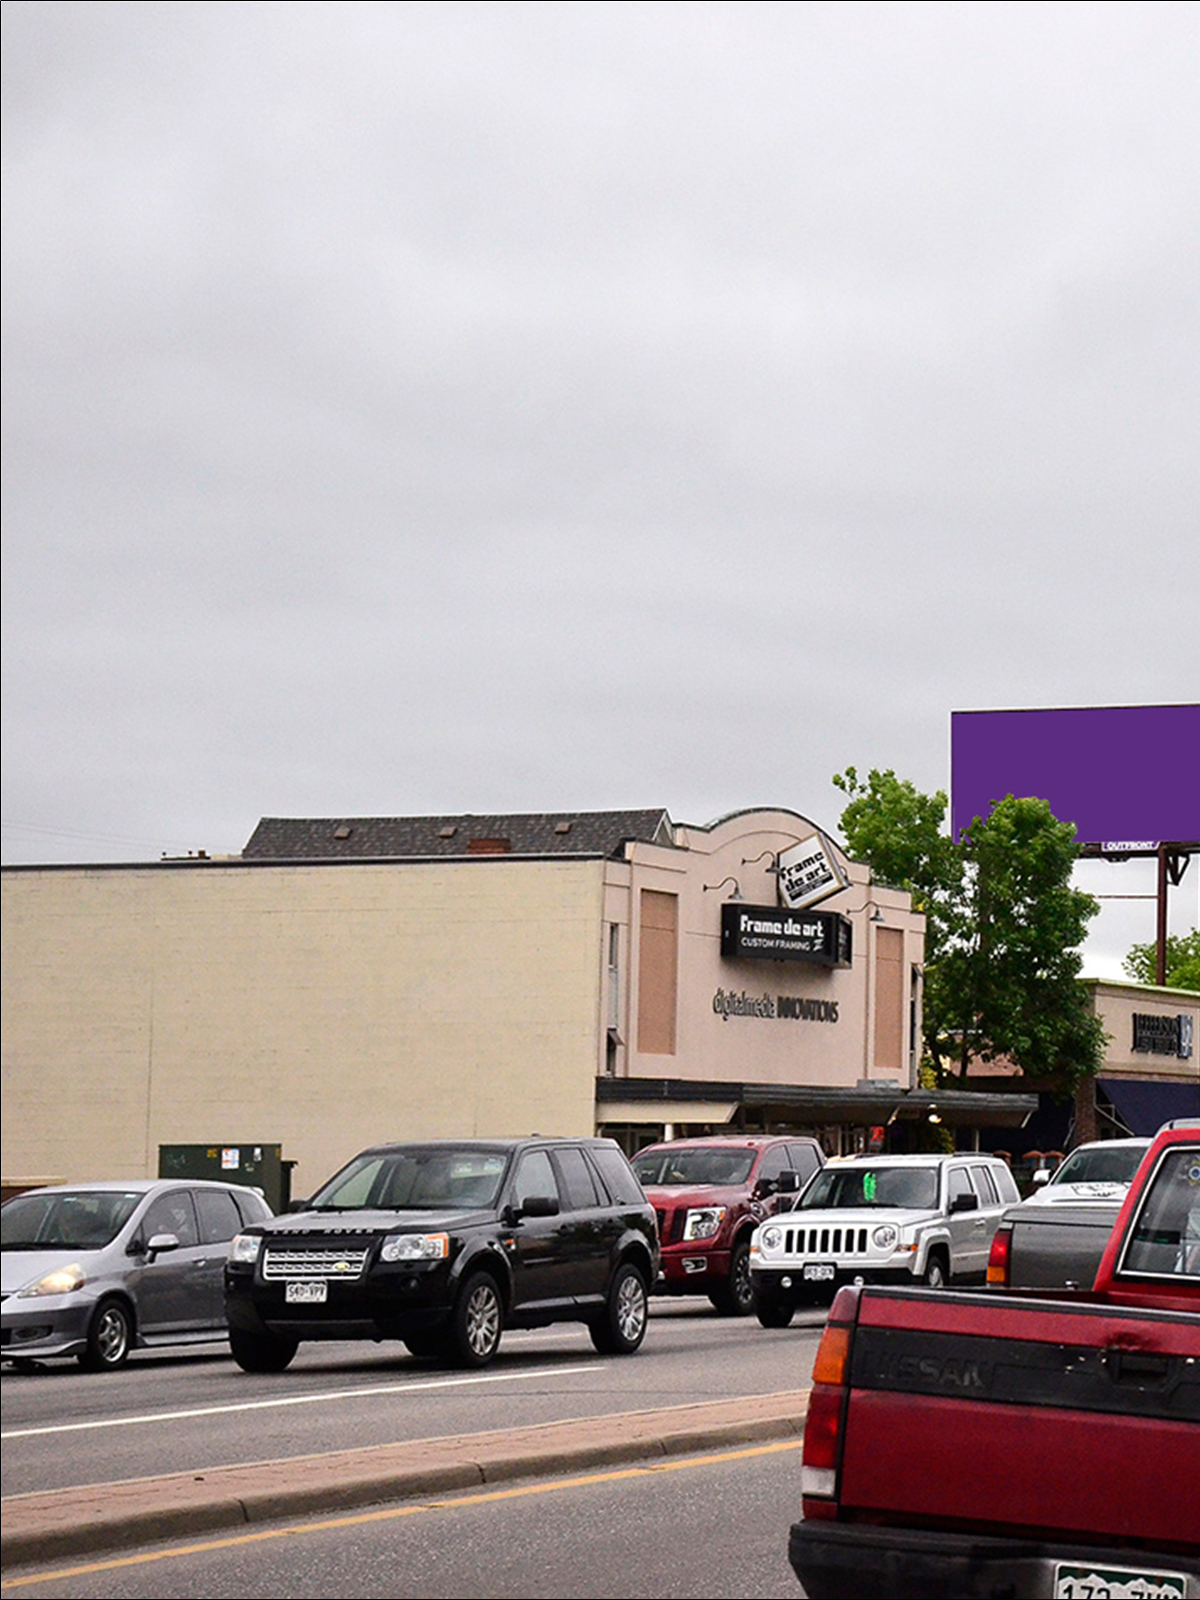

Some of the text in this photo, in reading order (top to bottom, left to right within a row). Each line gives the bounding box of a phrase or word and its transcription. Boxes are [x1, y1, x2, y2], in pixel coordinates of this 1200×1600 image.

[805, 861, 830, 881] art
[784, 917, 801, 936] de
[802, 920, 825, 938] art
[741, 937, 811, 951] CUSTOM FRAMING
